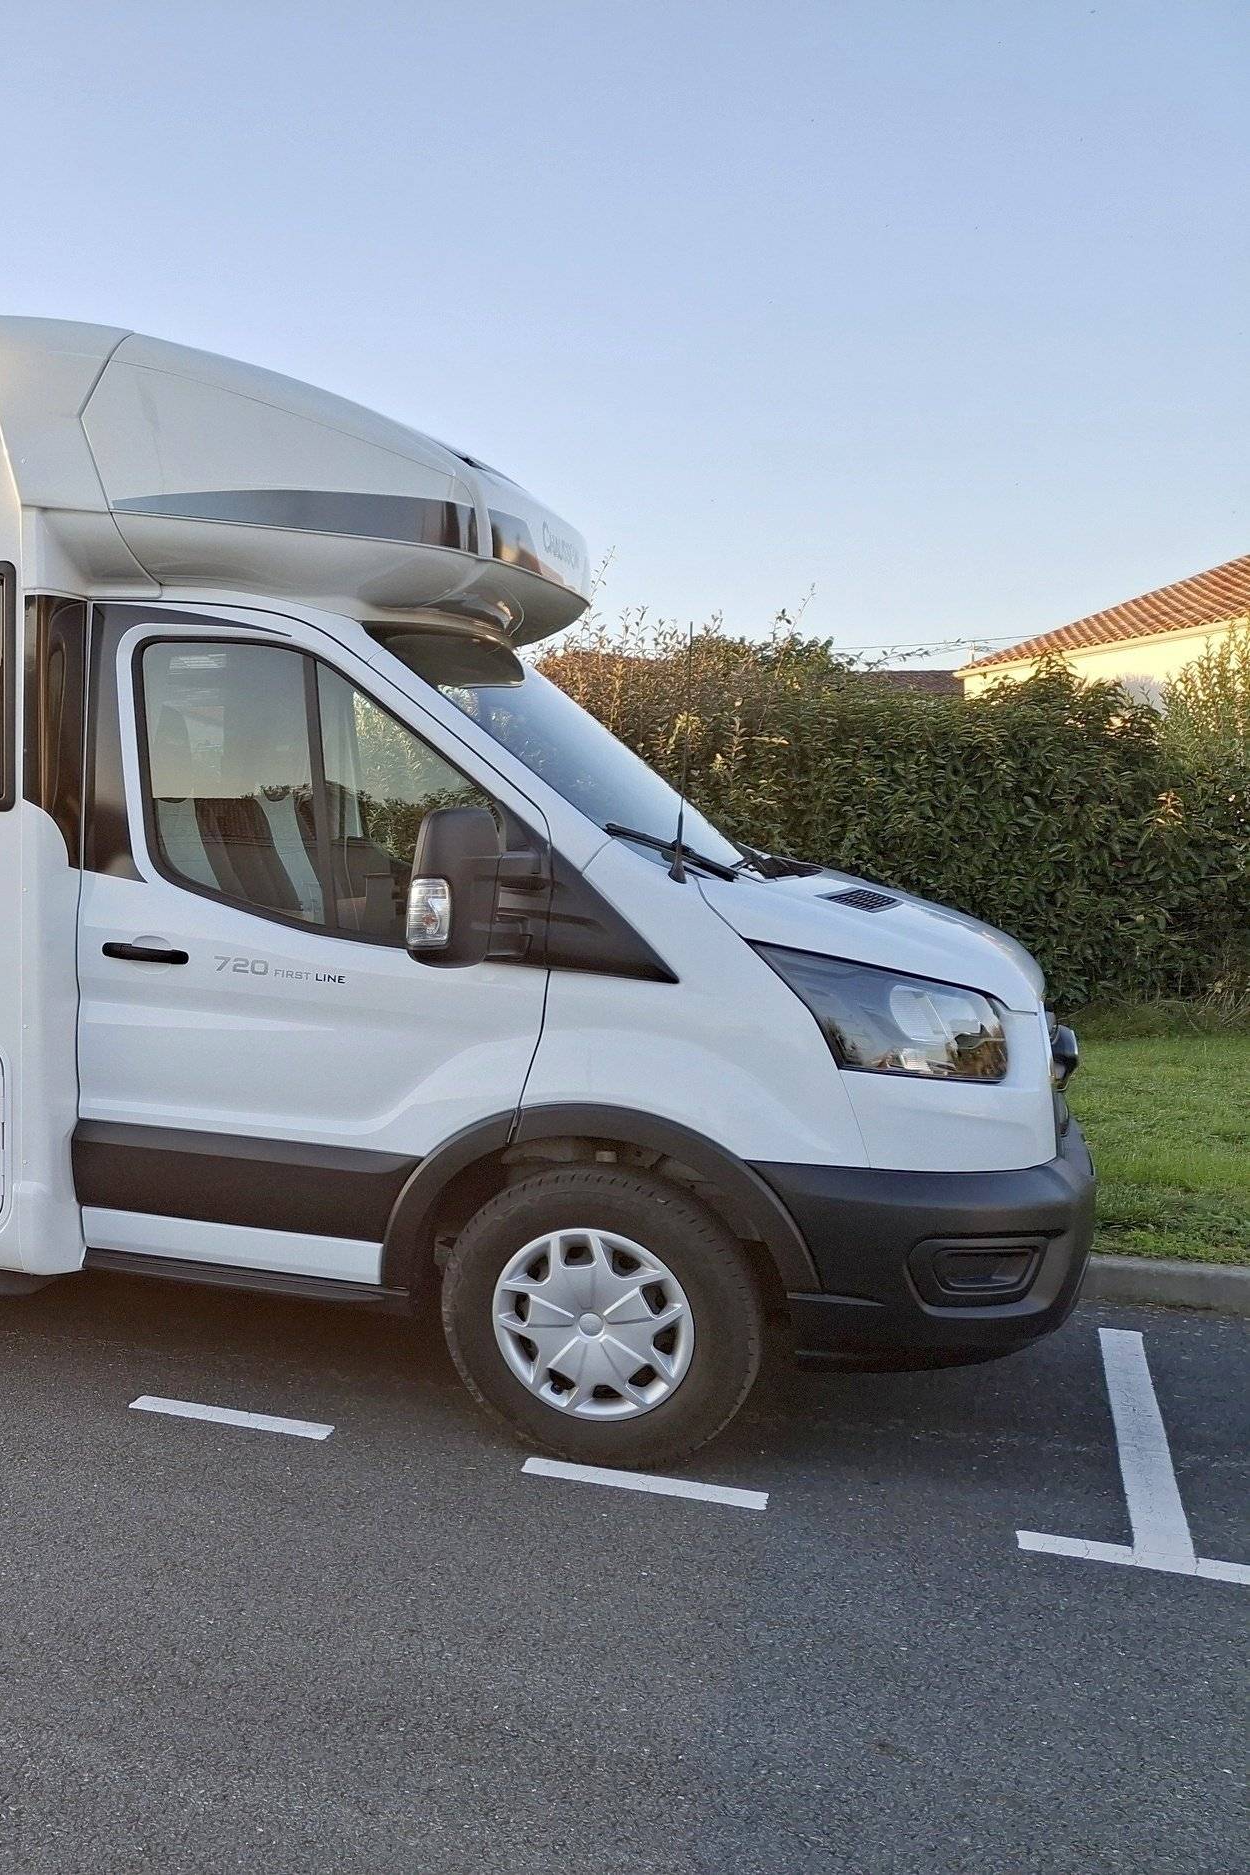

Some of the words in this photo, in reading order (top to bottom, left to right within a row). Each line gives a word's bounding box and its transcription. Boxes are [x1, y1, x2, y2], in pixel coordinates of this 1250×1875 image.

[213, 955, 269, 976] 720
[273, 968, 311, 981] FIRST
[315, 973, 347, 984] LINE
